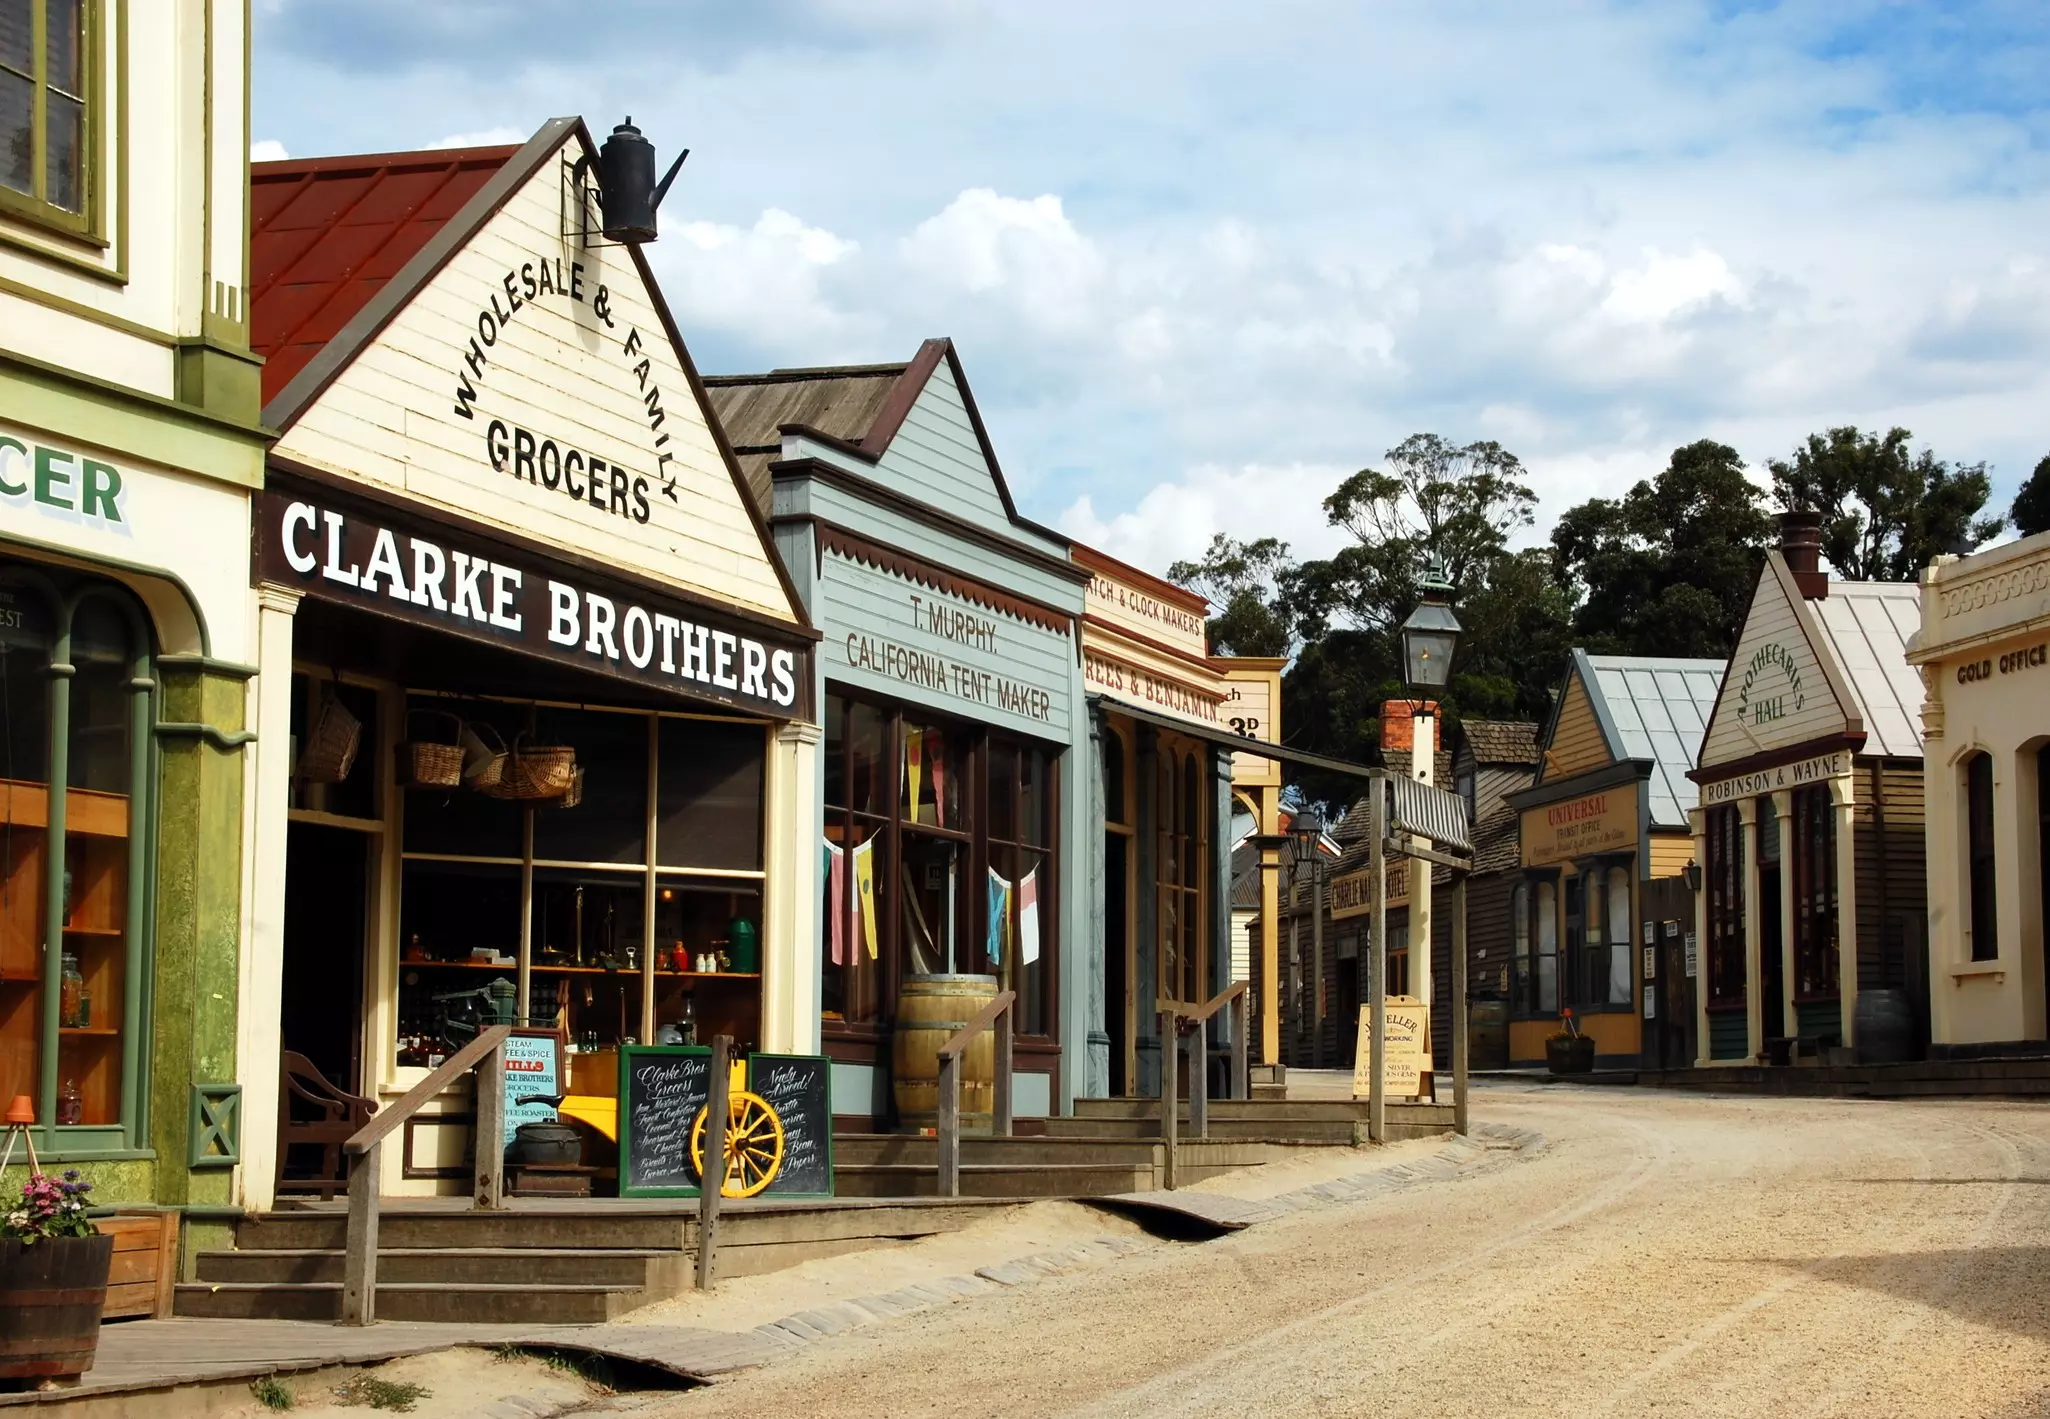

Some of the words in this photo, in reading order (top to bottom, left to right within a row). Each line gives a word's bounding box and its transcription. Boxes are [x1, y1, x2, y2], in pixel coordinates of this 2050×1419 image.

[454, 257, 584, 421] WHOLESALE
[594, 284, 614, 329] &
[623, 327, 678, 504] FAMILY
[487, 419, 650, 524] GROCERS
[282, 501, 522, 632] CLARKE
[548, 581, 796, 707] BROTHERS
[1119, 588, 1126, 608] &
[1129, 592, 1160, 623] CLOCK
[1162, 605, 1200, 637] MAKERS
[910, 595, 923, 630] T.
[929, 601, 998, 655] MURPHY.
[846, 632, 948, 692] CALIFORNIA
[950, 664, 992, 704] TENT
[997, 677, 1050, 722] MAKER
[1085, 654, 1123, 690] REES
[1130, 670, 1140, 696] &
[1737, 644, 1804, 723] APOTHECARIES
[1957, 659, 1992, 684] GOLD
[1999, 643, 2048, 674] OFFICE
[1755, 696, 1786, 725] HALL
[1708, 773, 1770, 801] ROBINSON
[1777, 769, 1785, 786] &
[1793, 754, 1840, 781] WAYNE
[1548, 796, 1608, 826] UNIVERSAL
[1557, 825, 1579, 839] TRANSIT
[1581, 820, 1601, 835] OFFICE
[1365, 1014, 1417, 1034] JELLER
[527, 1050, 551, 1058] SPICE
[519, 1074, 554, 1083] BROTHERS
[637, 1066, 681, 1086] Clarke
[521, 1109, 556, 1118] ROASTER
